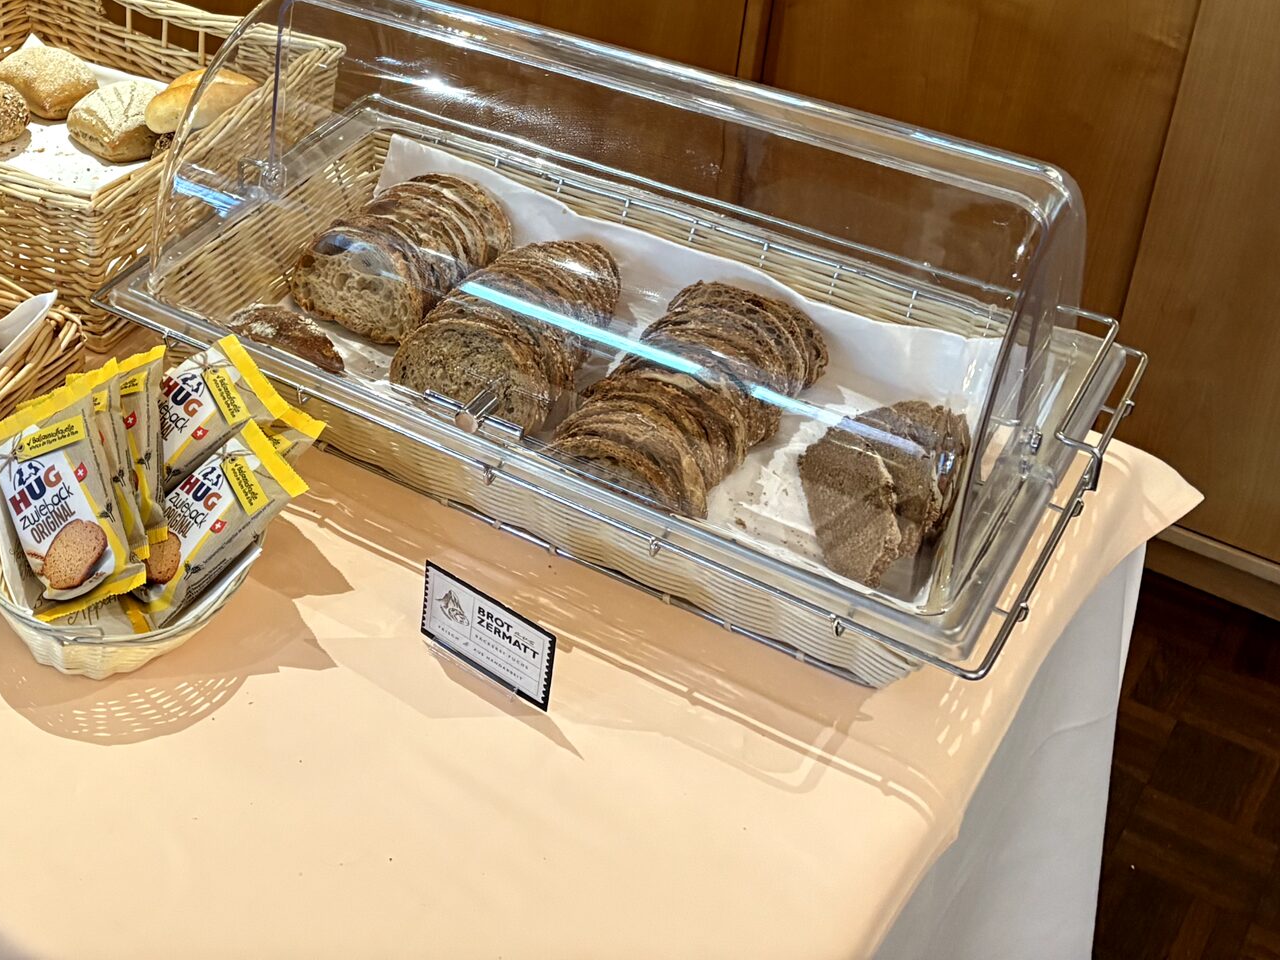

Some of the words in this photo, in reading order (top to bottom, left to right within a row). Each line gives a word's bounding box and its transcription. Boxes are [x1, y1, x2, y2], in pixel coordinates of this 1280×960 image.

[159, 375, 204, 418] HUG
[9, 464, 63, 516] HUG
[179, 473, 223, 512] HUG
[31, 501, 76, 544] ORIGINAL
[164, 505, 195, 539] ORIGINAL
[476, 615, 540, 660] ZERMATT
[477, 605, 513, 633] BROT
